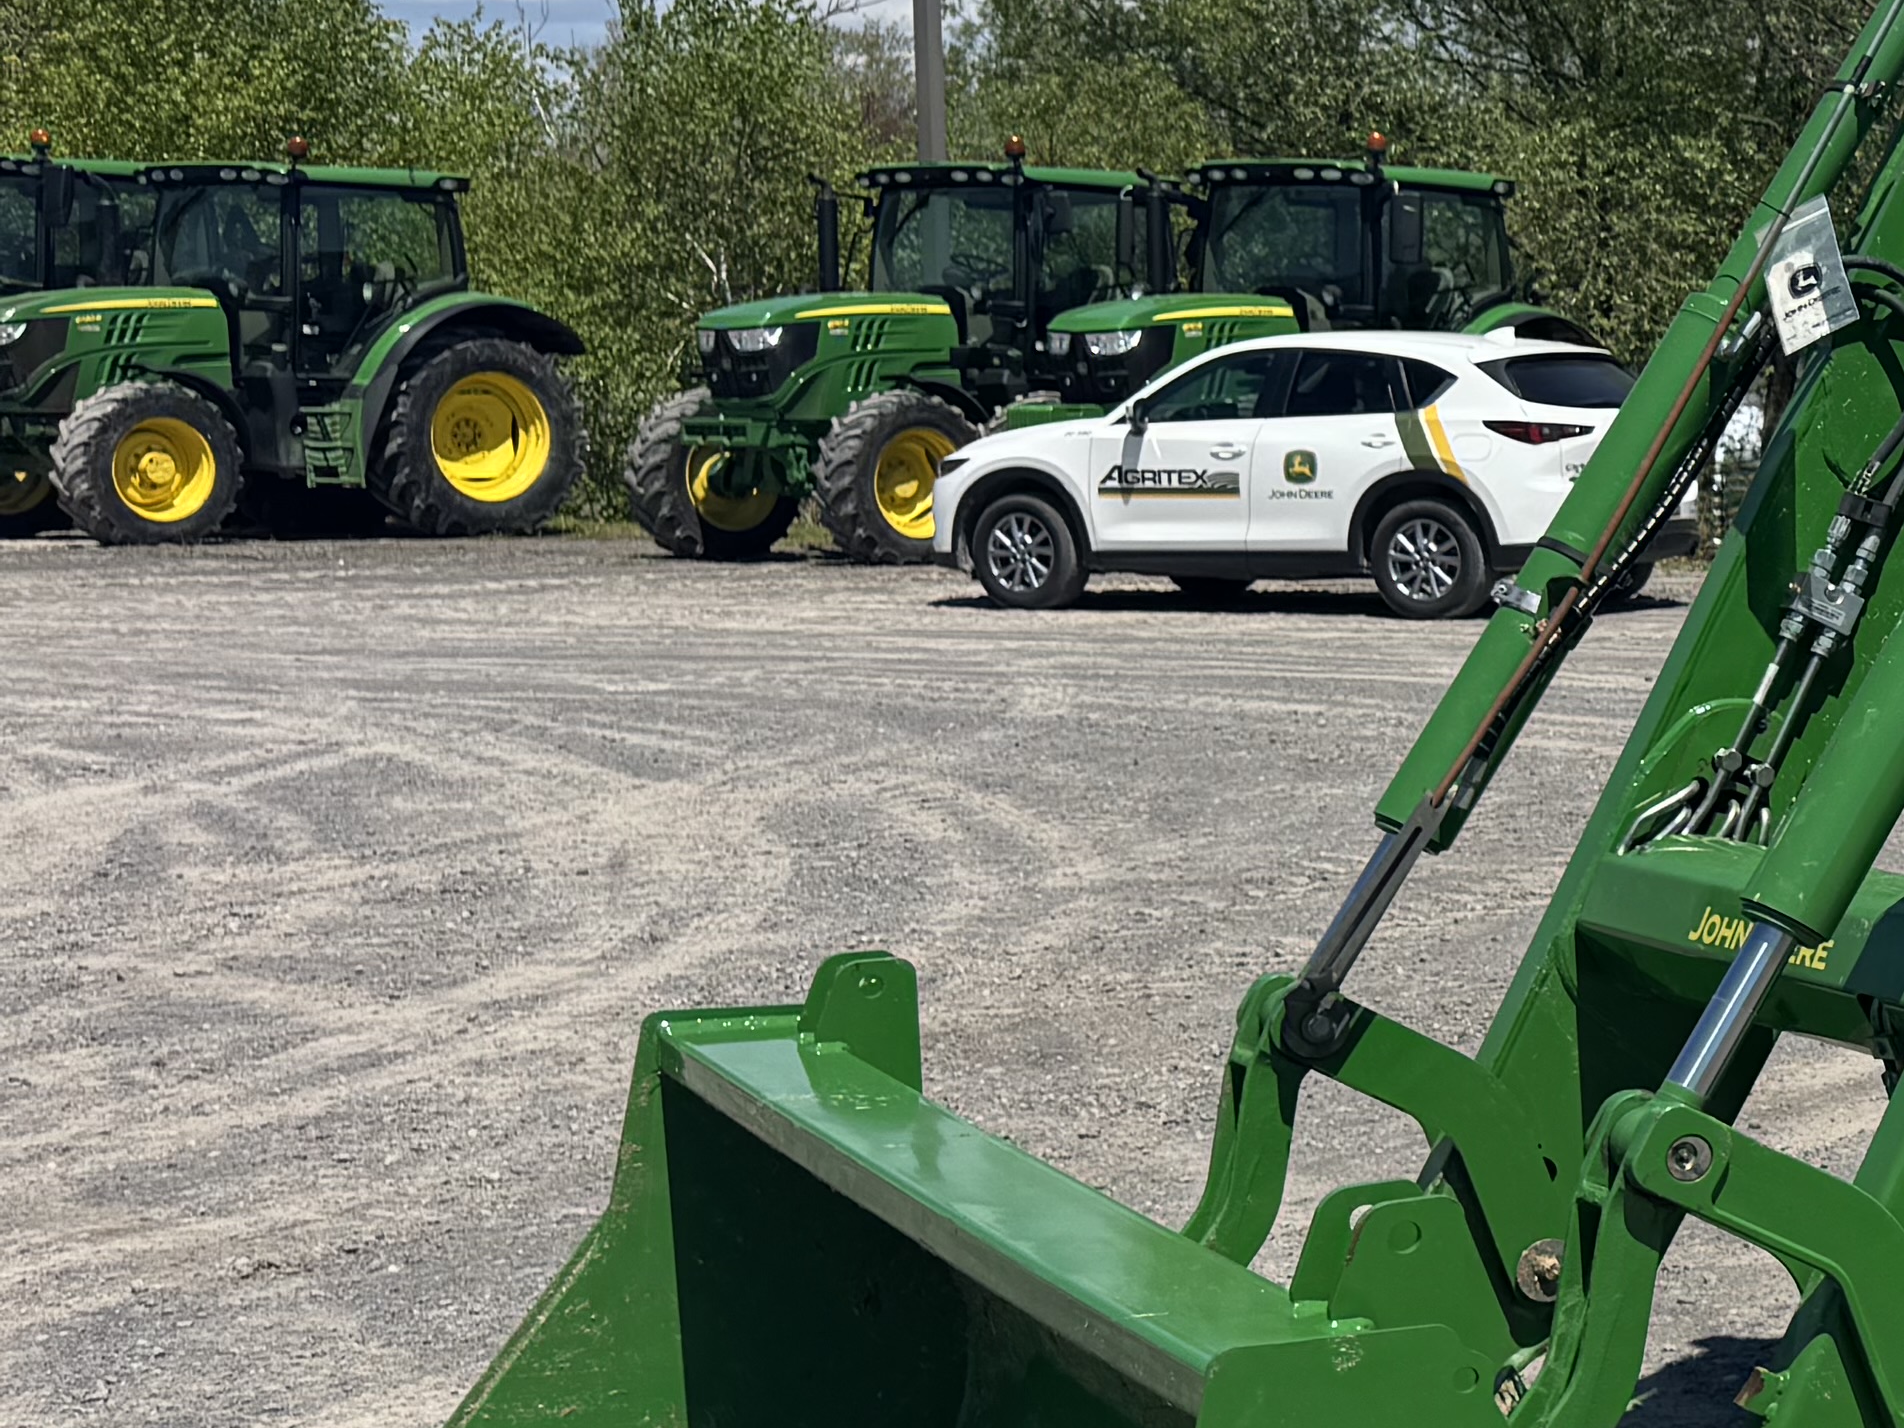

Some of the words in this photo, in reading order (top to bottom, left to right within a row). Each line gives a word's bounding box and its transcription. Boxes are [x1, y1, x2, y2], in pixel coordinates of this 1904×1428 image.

[1099, 464, 1211, 488] AGRITEX
[1268, 489, 1298, 500] JOHN
[1299, 489, 1334, 500] DEERE
[1687, 905, 1755, 950] JOHN
